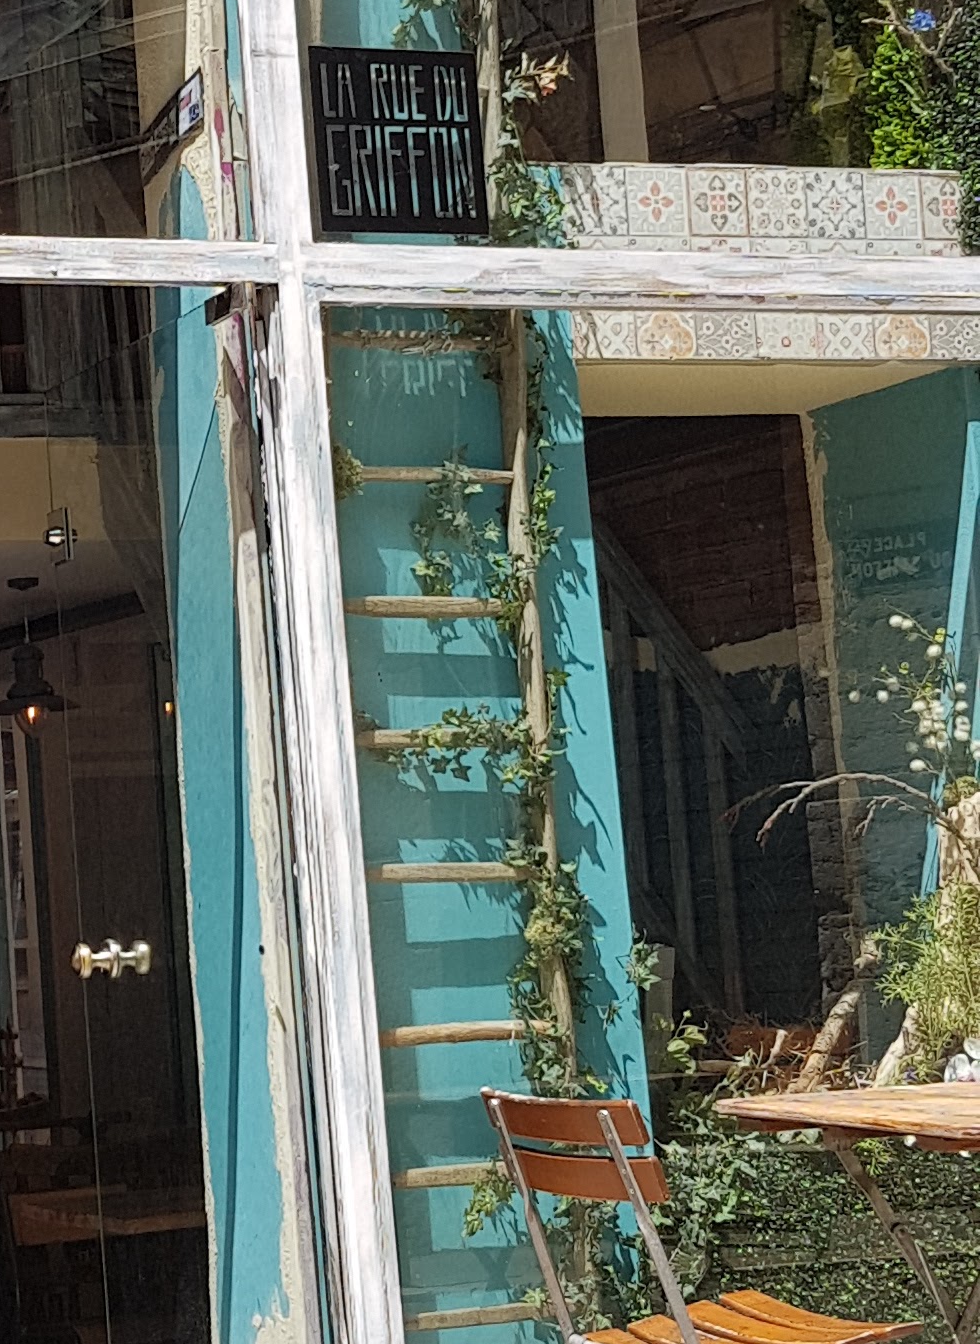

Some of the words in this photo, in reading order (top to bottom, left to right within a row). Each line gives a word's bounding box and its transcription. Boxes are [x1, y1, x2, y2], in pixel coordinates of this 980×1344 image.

[320, 63, 357, 118] LA
[370, 63, 427, 121] RUE
[433, 65, 469, 122] DU
[325, 124, 477, 218] GRIFFON
